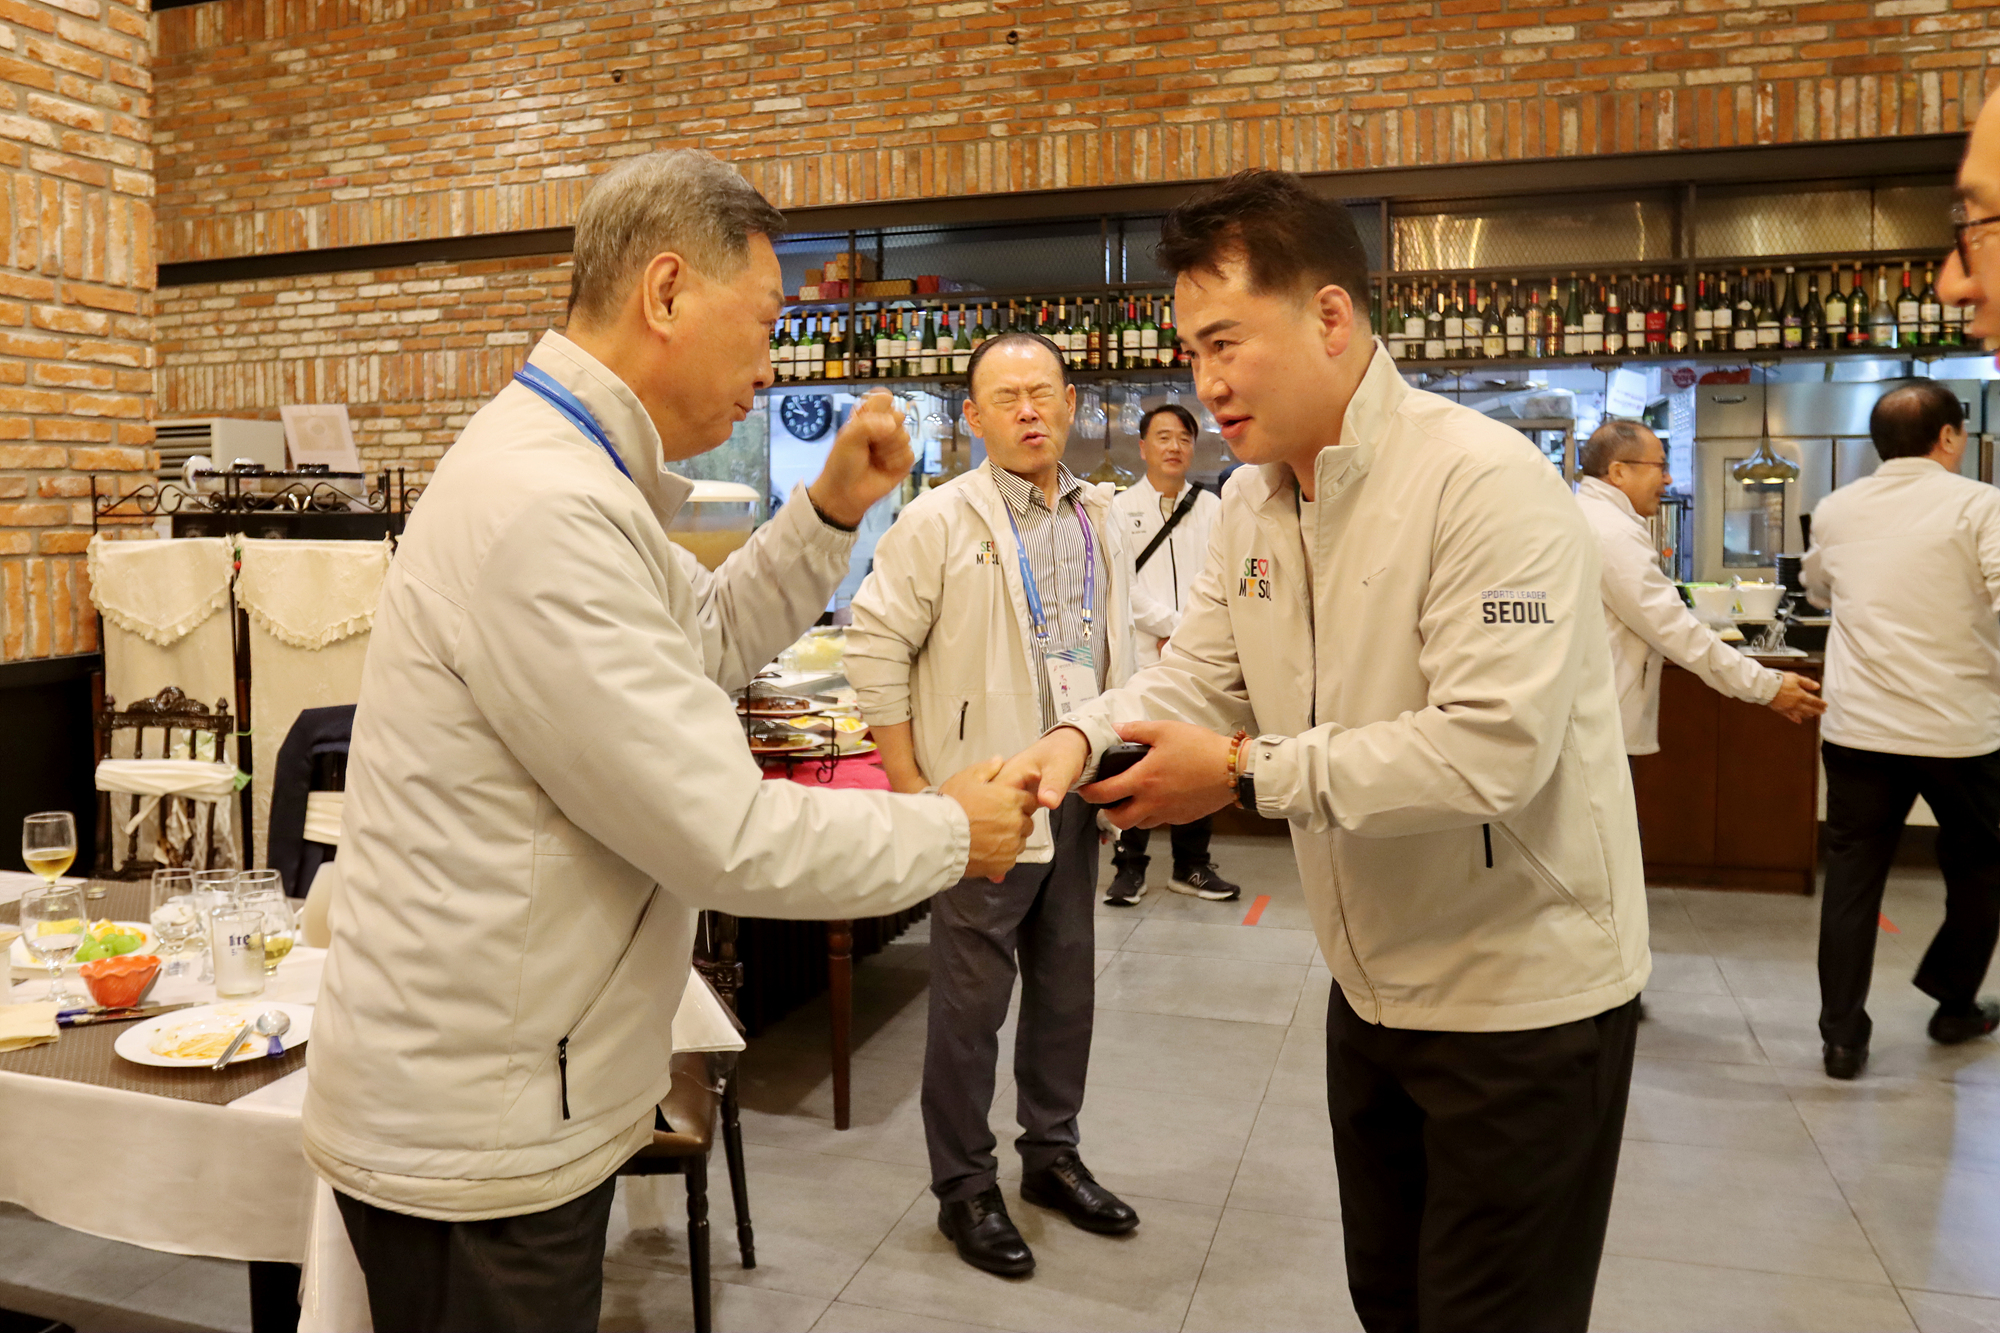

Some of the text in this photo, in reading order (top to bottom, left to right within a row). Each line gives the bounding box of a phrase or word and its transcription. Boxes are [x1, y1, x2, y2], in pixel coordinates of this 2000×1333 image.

[1481, 590, 1546, 599] SPORTS LEADER
[1482, 601, 1555, 624] SEOUL
